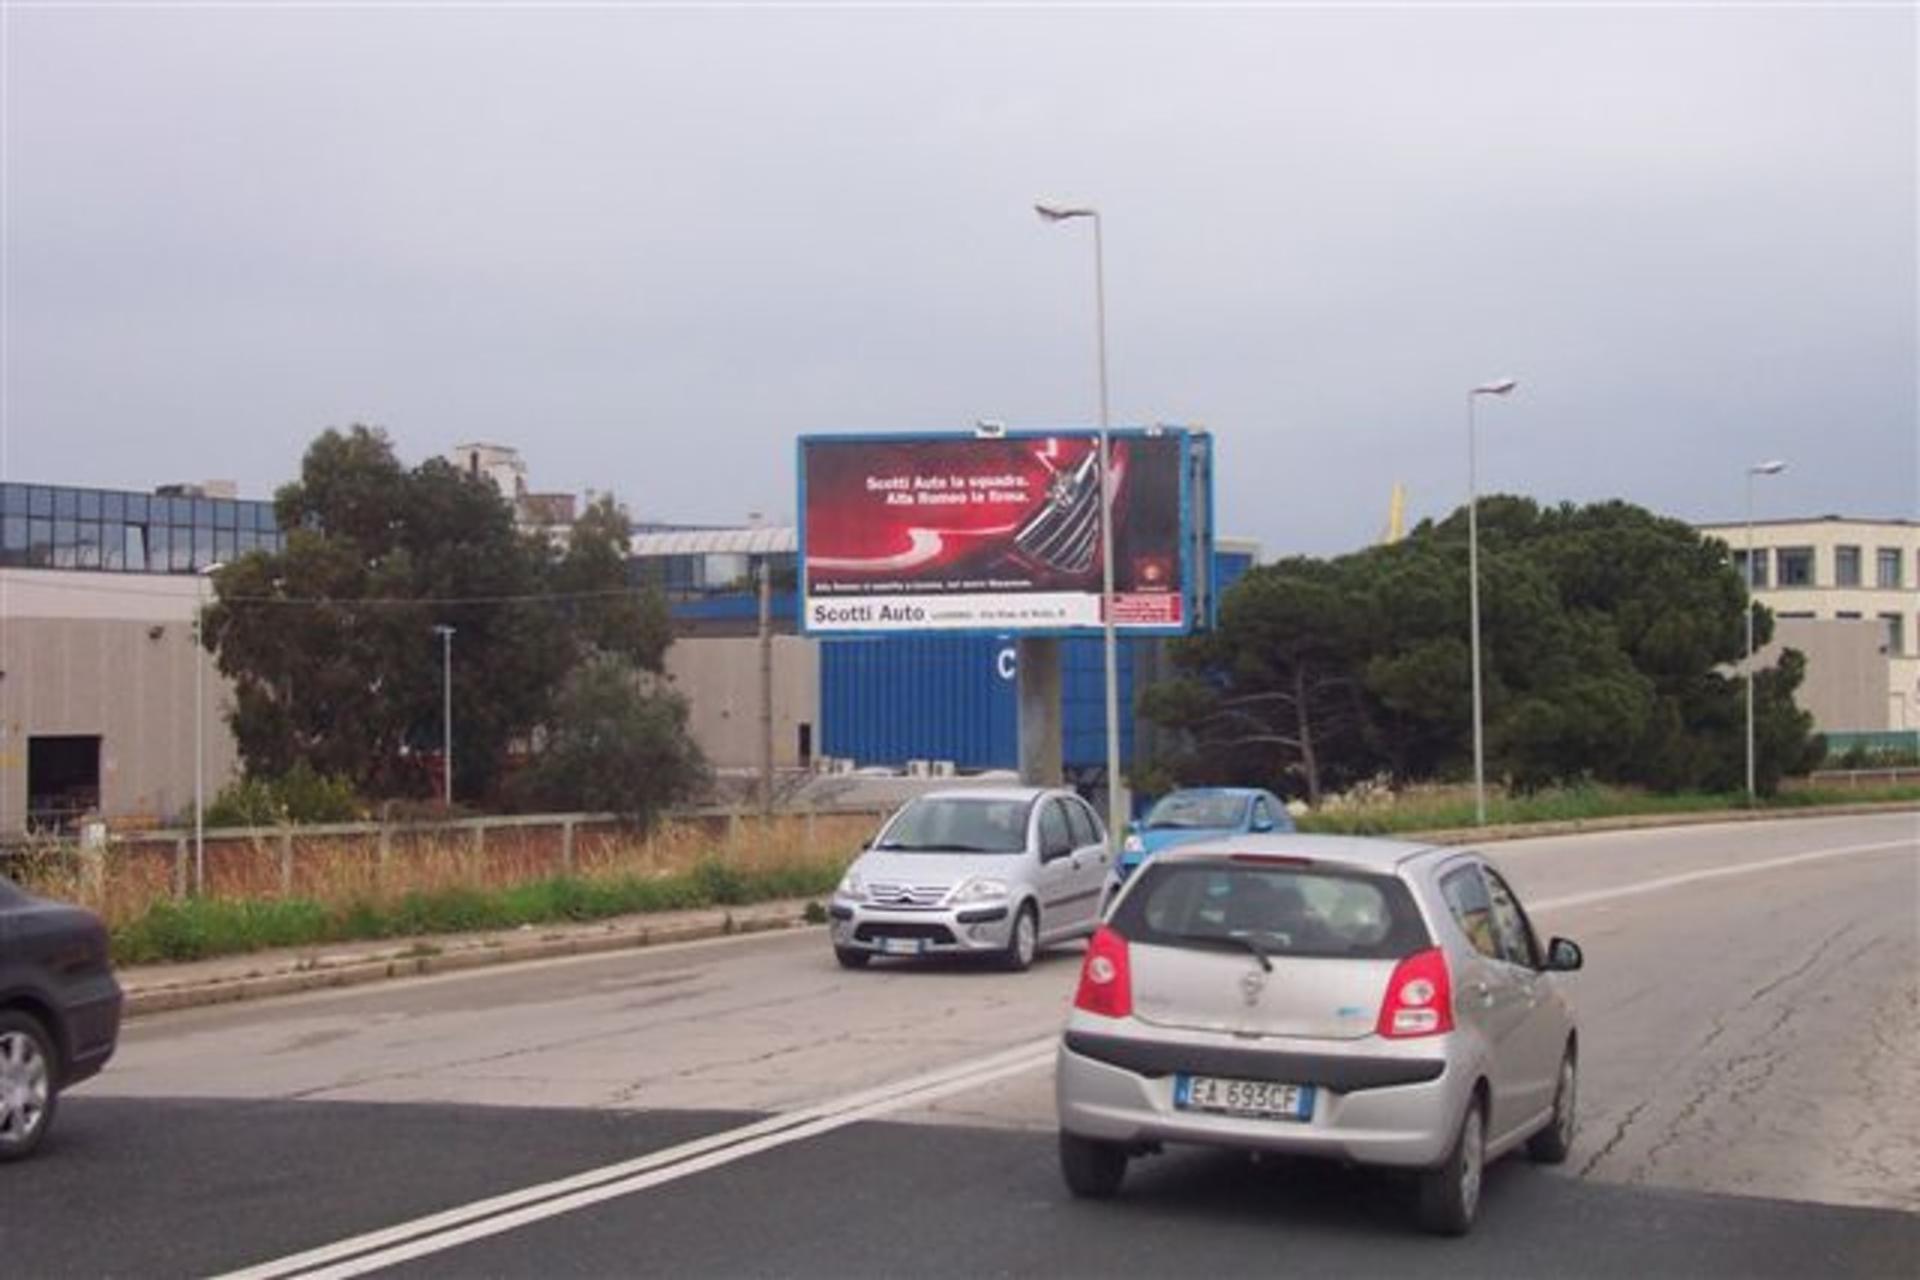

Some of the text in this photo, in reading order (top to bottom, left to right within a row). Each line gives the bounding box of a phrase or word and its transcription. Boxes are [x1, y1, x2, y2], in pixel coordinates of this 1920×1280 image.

[866, 475, 909, 490] Scotti
[914, 475, 946, 489] Auto
[887, 492, 913, 505] Alfa
[917, 491, 967, 504] Romeo
[815, 605, 871, 623] Scotti
[879, 604, 925, 622] Auto
[998, 648, 1016, 679] C
